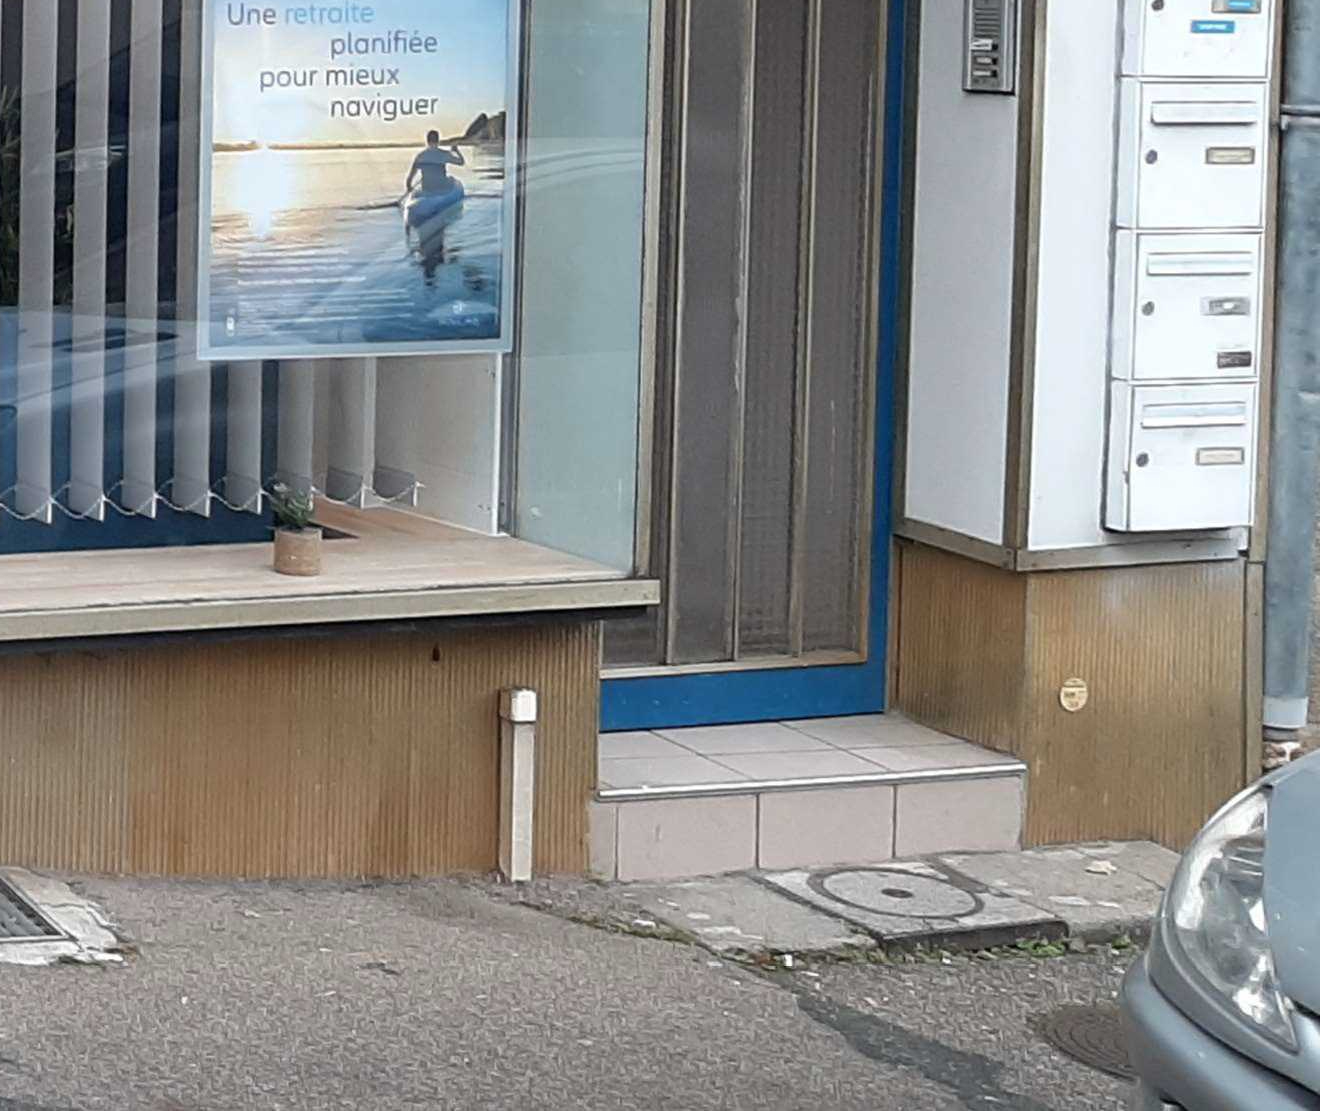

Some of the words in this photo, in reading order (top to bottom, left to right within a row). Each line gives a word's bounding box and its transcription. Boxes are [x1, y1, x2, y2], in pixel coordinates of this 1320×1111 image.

[226, 3, 277, 27] Une
[284, 1, 376, 26] retraite
[330, 29, 439, 61] planifiée
[258, 67, 317, 93] pour
[325, 64, 400, 86] mieux
[330, 95, 439, 121] naviguer
